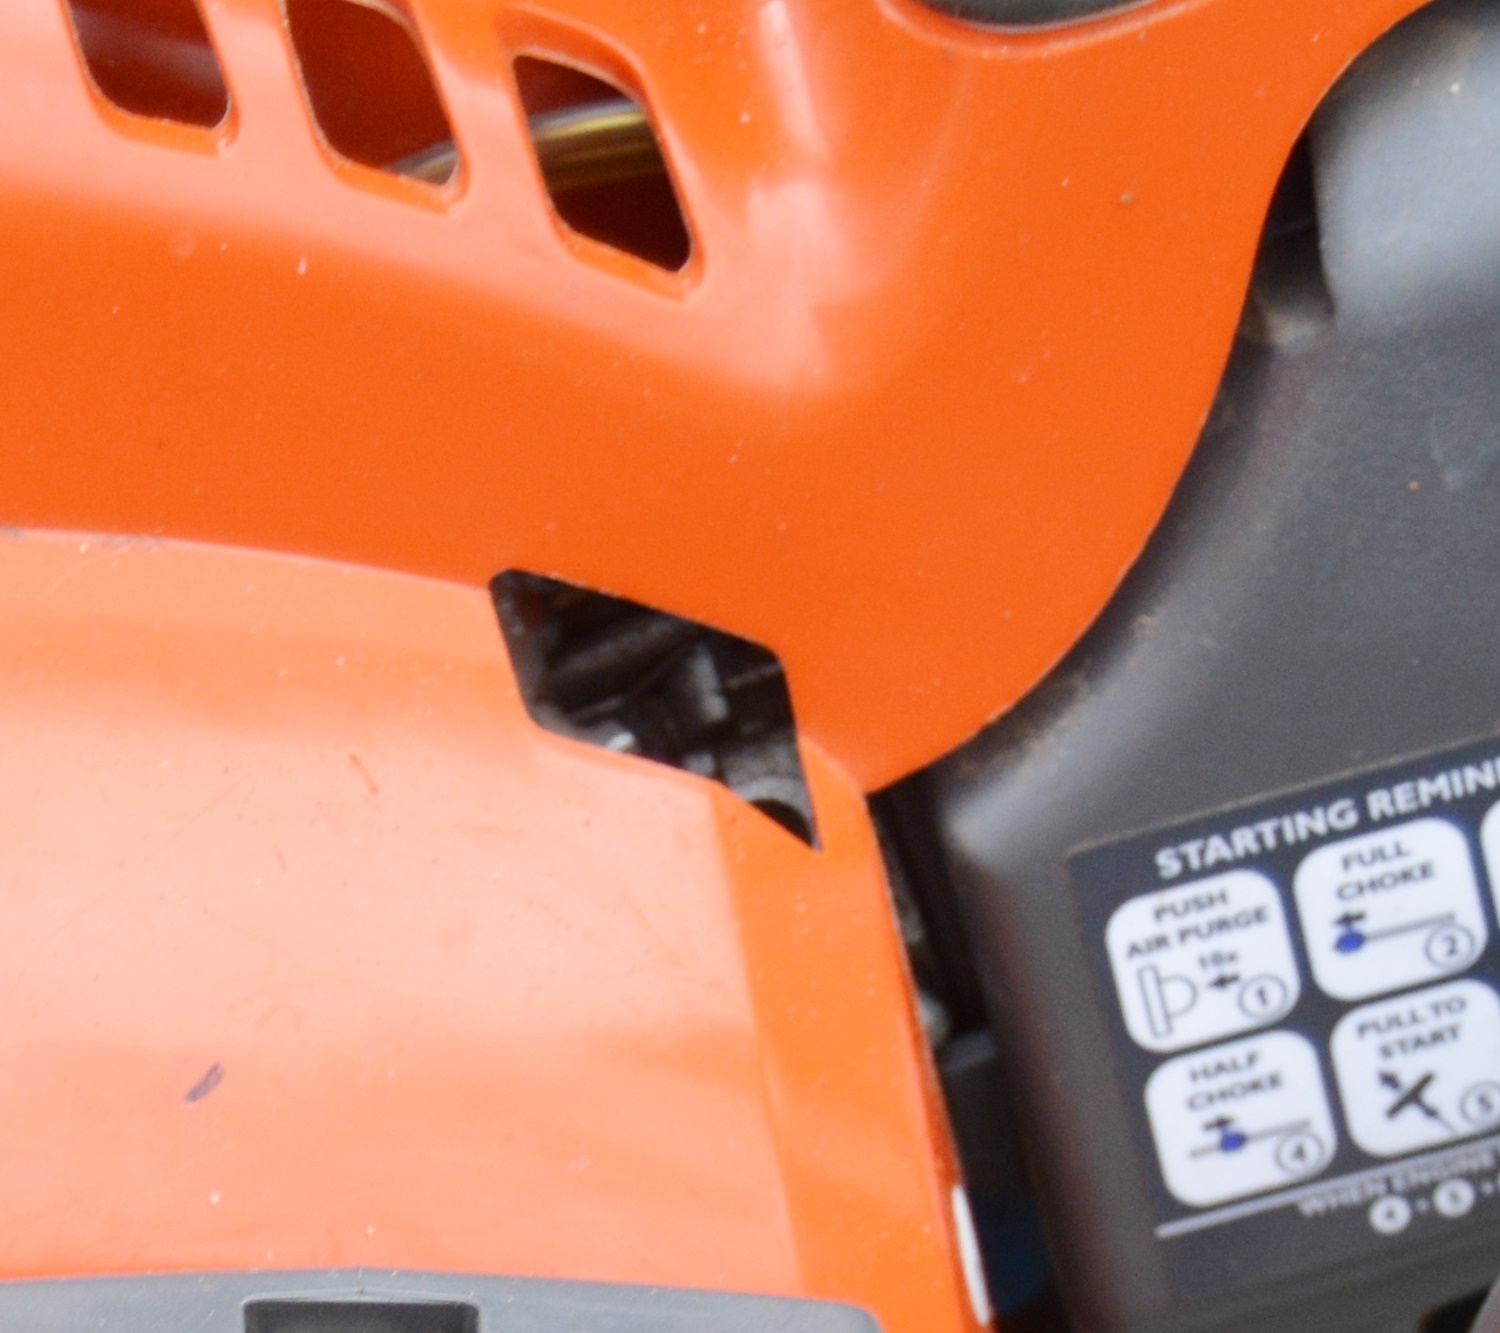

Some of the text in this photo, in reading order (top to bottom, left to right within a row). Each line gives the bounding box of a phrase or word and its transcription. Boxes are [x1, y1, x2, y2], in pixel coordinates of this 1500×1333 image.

[1154, 798, 1360, 879] STARTING
[1341, 840, 1411, 871] FULL
[1336, 862, 1435, 901] CHOKE
[1154, 889, 1228, 922] PUSH
[1127, 905, 1269, 959] AIR PURGE
[1357, 997, 1467, 1039] PULL TO
[1379, 1026, 1462, 1061] START
[1188, 1050, 1260, 1082] HALF
[1187, 1071, 1283, 1111] CHOKE
